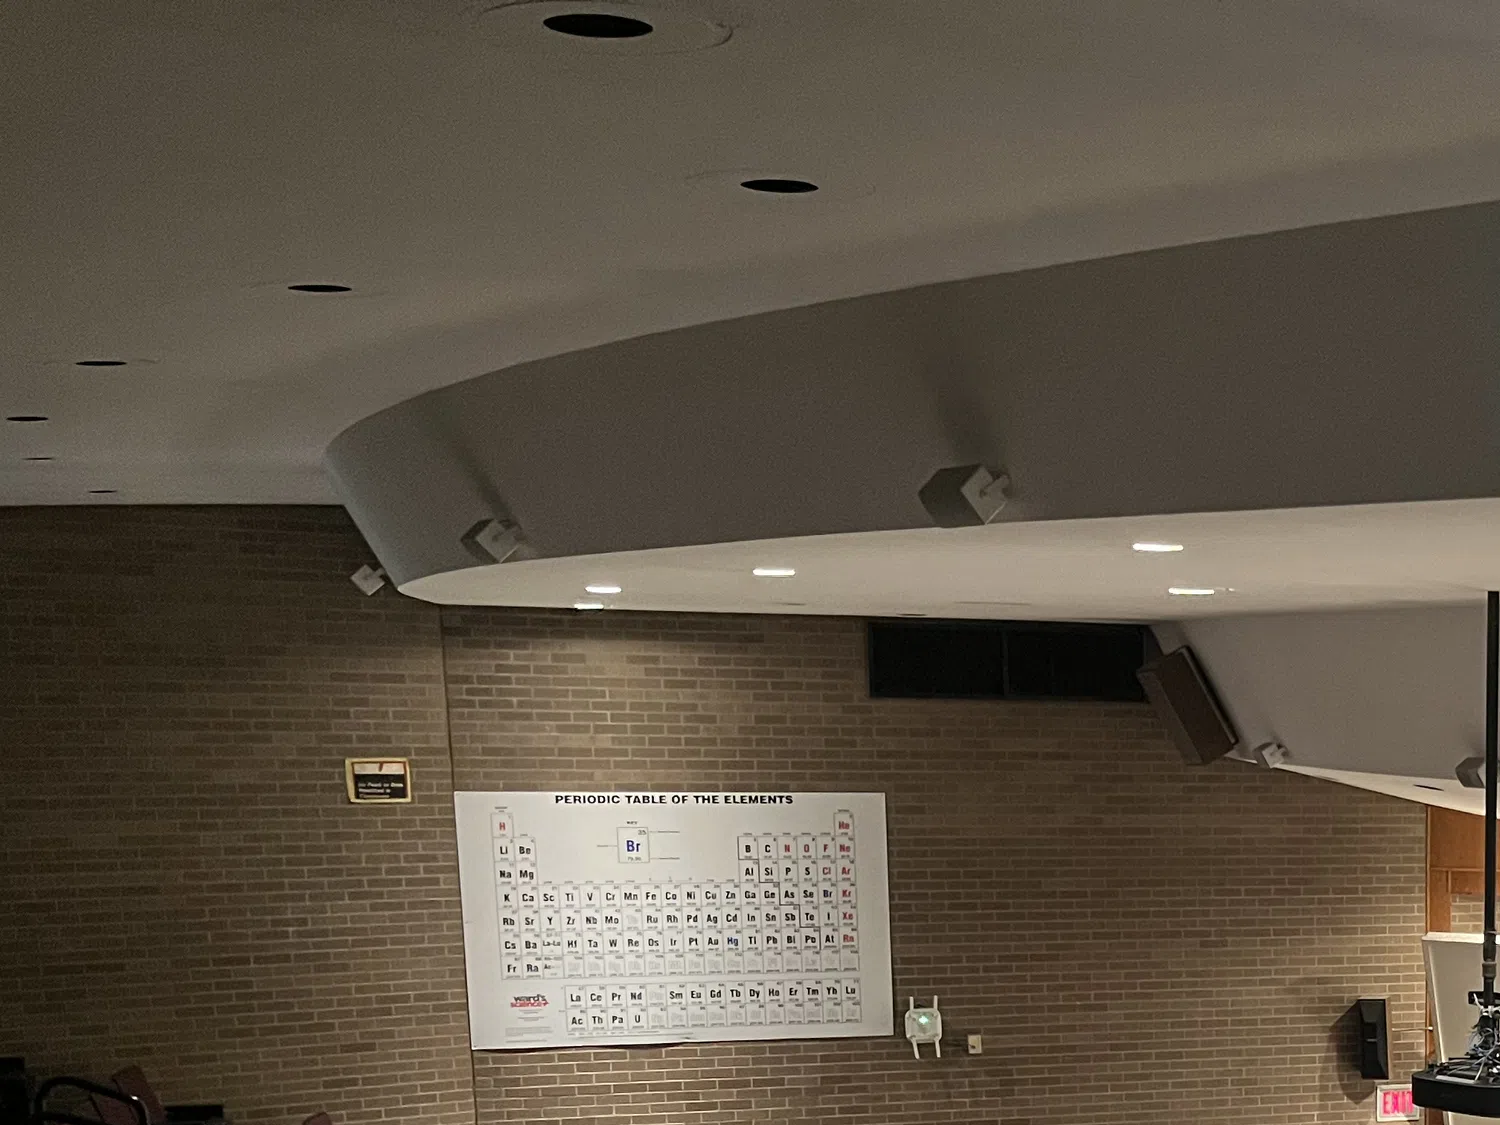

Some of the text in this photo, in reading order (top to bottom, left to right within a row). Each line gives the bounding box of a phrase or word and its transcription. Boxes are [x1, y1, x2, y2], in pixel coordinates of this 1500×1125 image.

[555, 795, 793, 804] PERIODIC TABLE OF THE ELEMENTS
[499, 821, 850, 830] H He
[500, 844, 850, 854] Li Be B C N O F Ne
[626, 840, 640, 852] Br
[499, 867, 850, 880] Na Mg Al Si P S Cl Ar
[504, 894, 510, 902] K
[522, 893, 534, 902] Ca
[543, 893, 554, 901] Sc
[565, 893, 574, 901] Ti
[587, 893, 593, 901] V
[606, 892, 615, 901] Cr
[624, 892, 638, 900] Mn
[646, 892, 656, 900] Fe
[666, 892, 677, 900] Co
[705, 891, 716, 900] Cu
[726, 891, 735, 899] Zn
[745, 891, 756, 899] Ga
[784, 890, 795, 898] As
[803, 890, 814, 898] Se
[823, 890, 832, 898] Br
[525, 917, 534, 925] Sr
[547, 917, 552, 925] Y
[567, 916, 575, 925] Zr
[605, 916, 619, 924] Mo
[647, 915, 658, 923] Ru
[667, 915, 678, 923] Rh
[687, 915, 698, 923] Pd
[707, 914, 718, 924] Ag
[726, 914, 737, 922] Cd
[747, 913, 755, 921] In
[766, 913, 776, 921] Sn
[785, 913, 796, 921] Sb
[805, 913, 814, 921] Te
[827, 912, 830, 920] I
[842, 912, 853, 920] Xe
[505, 941, 516, 949] Cs
[525, 941, 537, 949] Ba
[568, 940, 577, 948] Hf
[588, 940, 598, 948] Ta
[609, 939, 617, 947] W
[628, 939, 639, 947] Re
[648, 938, 659, 946] Os
[670, 938, 677, 946] Ir
[689, 937, 698, 946] Pt
[708, 937, 719, 945] Au
[727, 937, 738, 947] Hg
[748, 936, 756, 944] Tl
[766, 936, 777, 944] Pb
[787, 936, 795, 944] Bi
[805, 935, 816, 943] Po
[825, 935, 834, 943] At
[843, 934, 854, 942] Rn
[507, 964, 516, 973] Fr
[526, 964, 539, 972] Ra
[570, 994, 581, 1002] La
[590, 993, 602, 1001] Ce
[612, 993, 621, 1001] Pr
[631, 992, 642, 1000] Nd
[670, 991, 683, 999] Sm
[710, 990, 721, 998] Gd
[730, 989, 741, 997] Tb
[749, 989, 760, 998] Dy
[769, 988, 779, 996] Ho
[789, 988, 798, 996] Er
[806, 987, 819, 995] Tm
[826, 987, 837, 995] Yb
[846, 986, 855, 994] Lu
[572, 1017, 583, 1025] Ac
[592, 1016, 603, 1024] Th
[635, 1015, 640, 1023] U
[1383, 1091, 1414, 1115] EXIT
